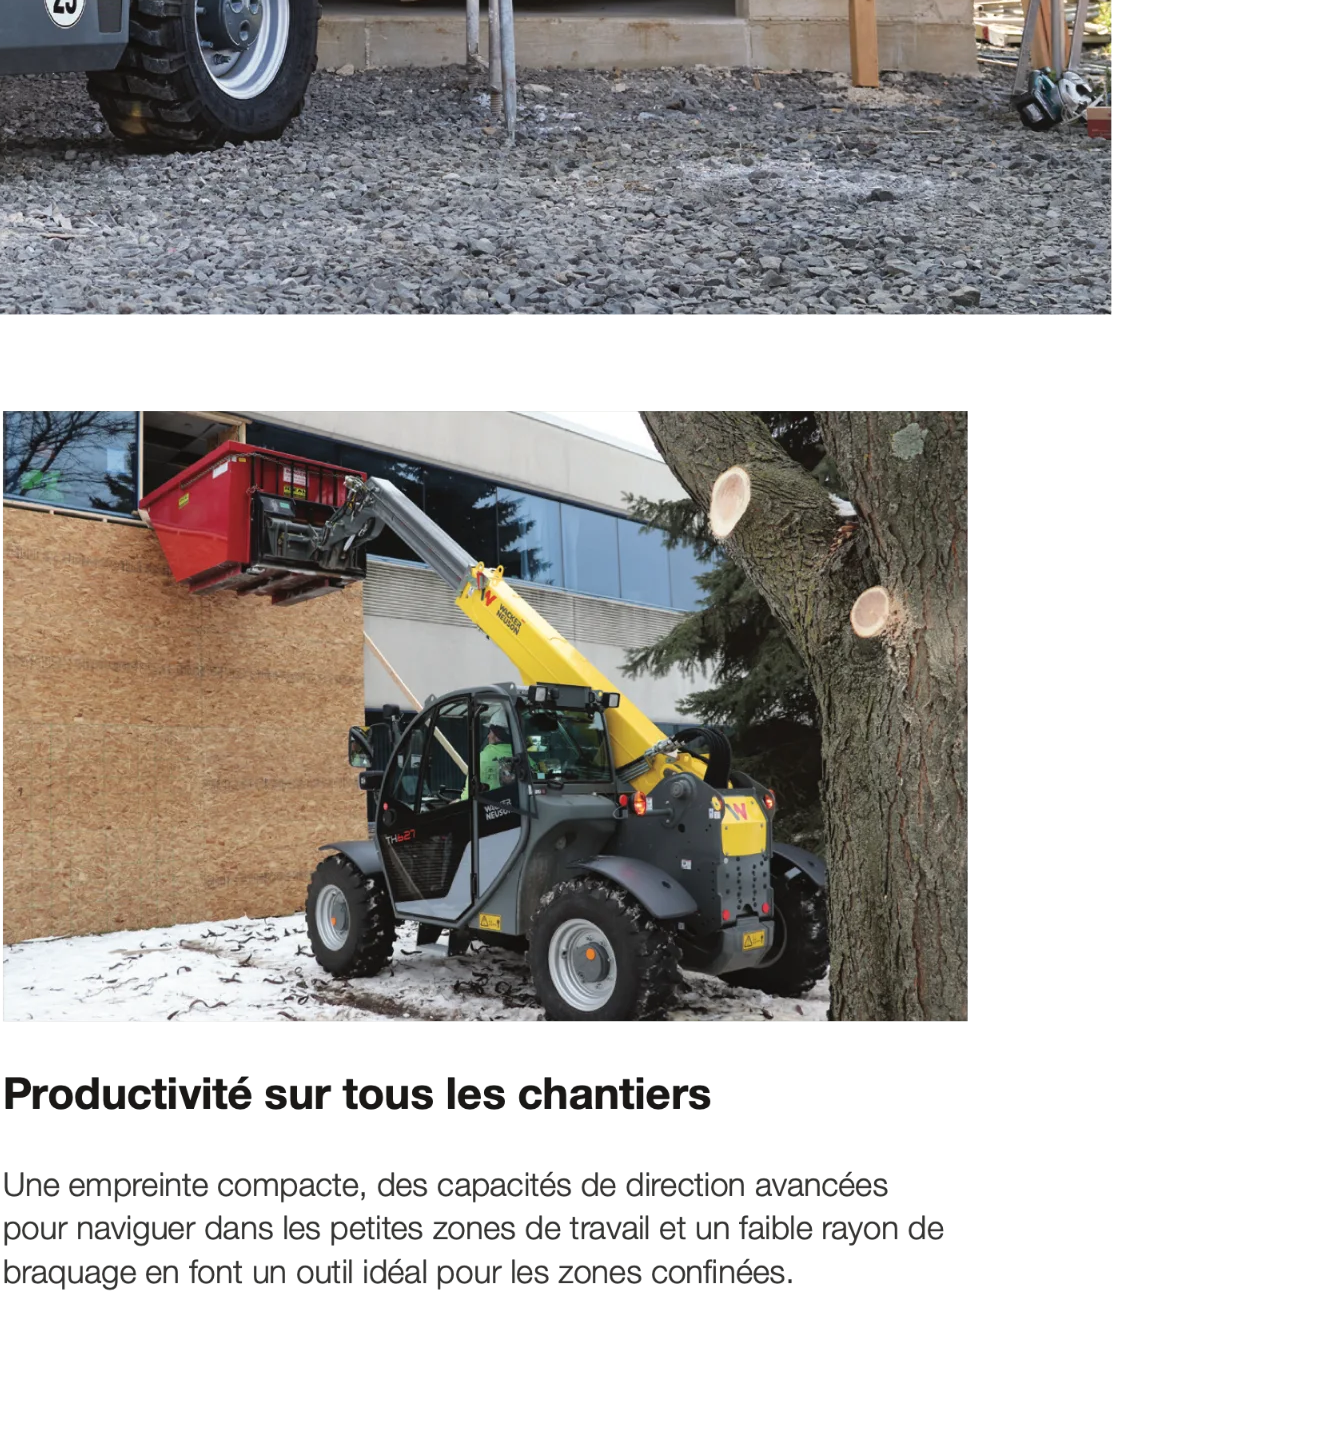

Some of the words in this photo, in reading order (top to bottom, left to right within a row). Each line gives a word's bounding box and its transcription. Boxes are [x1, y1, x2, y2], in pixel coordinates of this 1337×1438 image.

[496, 609, 520, 636] NEUSON
[499, 603, 522, 628] WACKER
[385, 829, 416, 844] TH627
